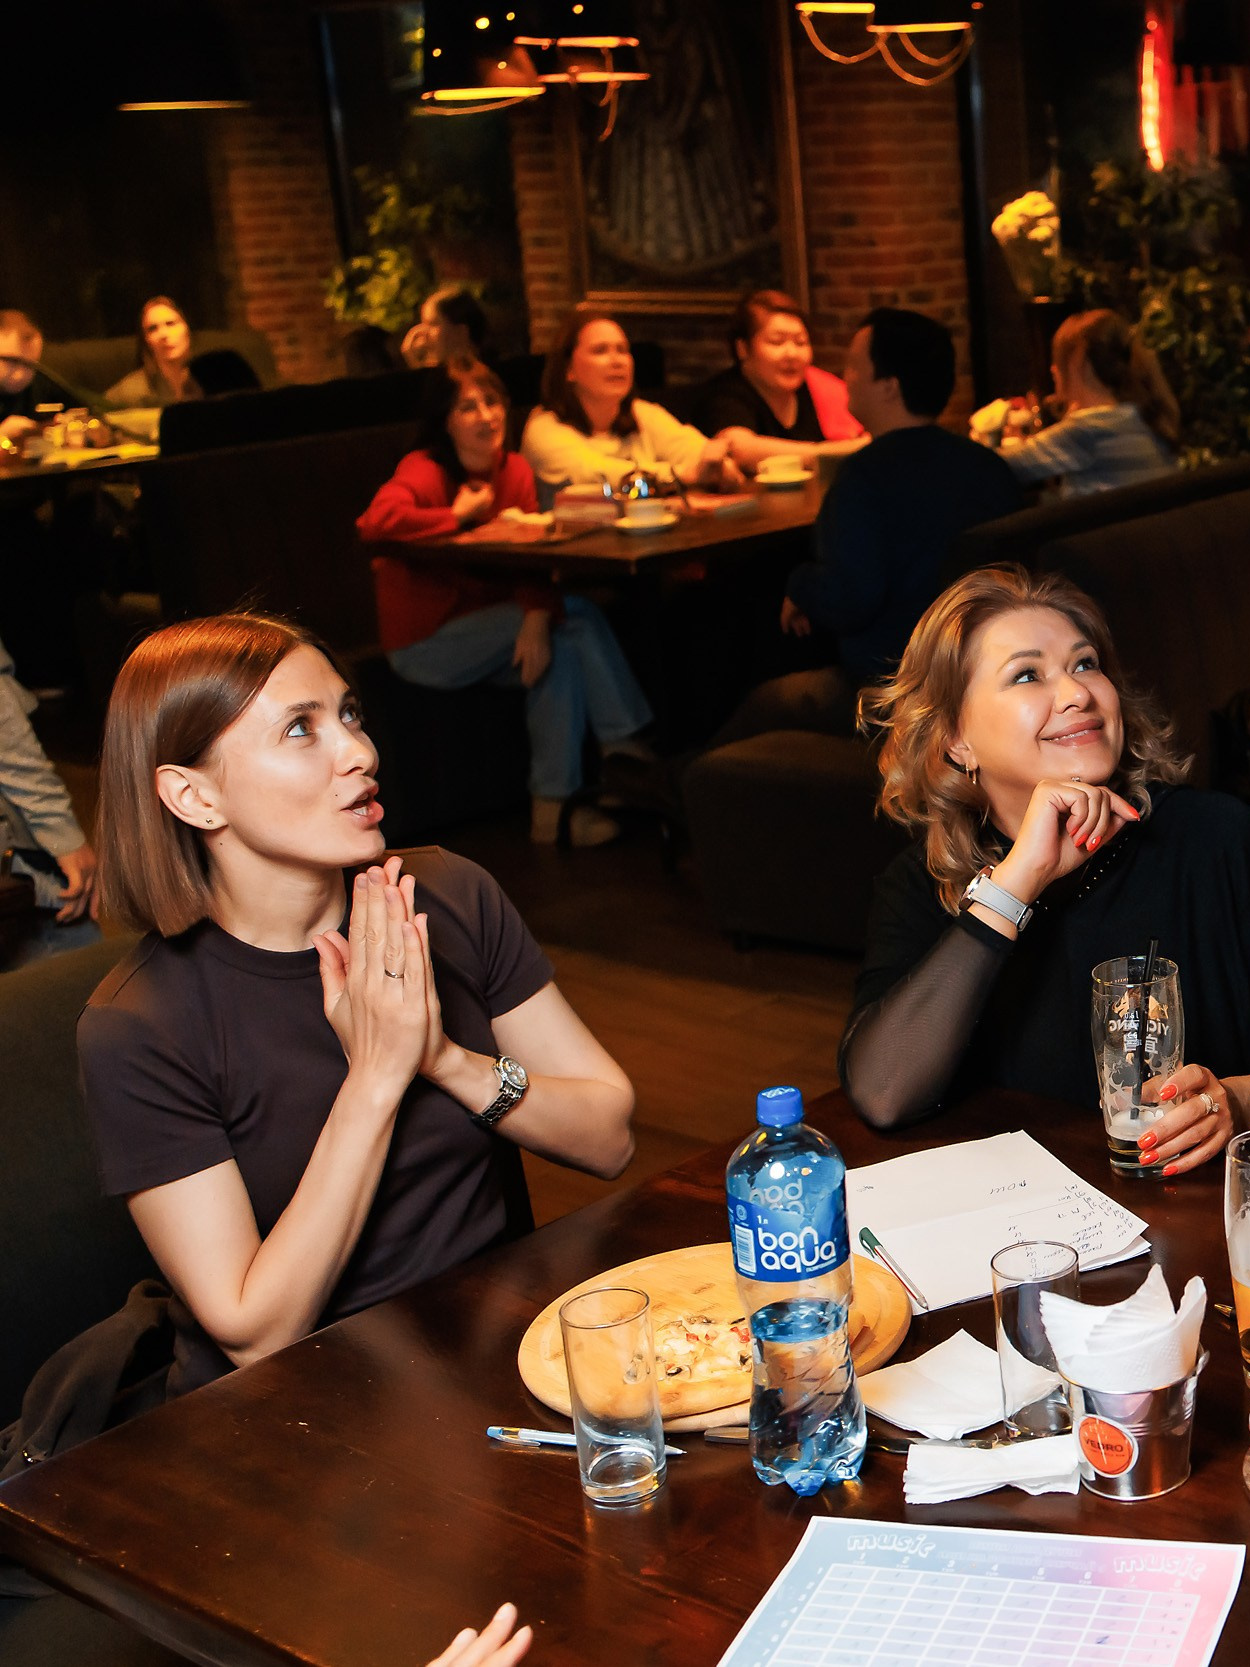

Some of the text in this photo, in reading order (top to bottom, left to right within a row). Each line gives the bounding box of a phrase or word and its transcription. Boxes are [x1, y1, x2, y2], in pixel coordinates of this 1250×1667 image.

[757, 1226, 819, 1251] bon
[760, 1240, 837, 1273] aqua
[1085, 1438, 1124, 1453] VEDRO
[847, 1533, 936, 1559] music
[1113, 1552, 1208, 1582] music
